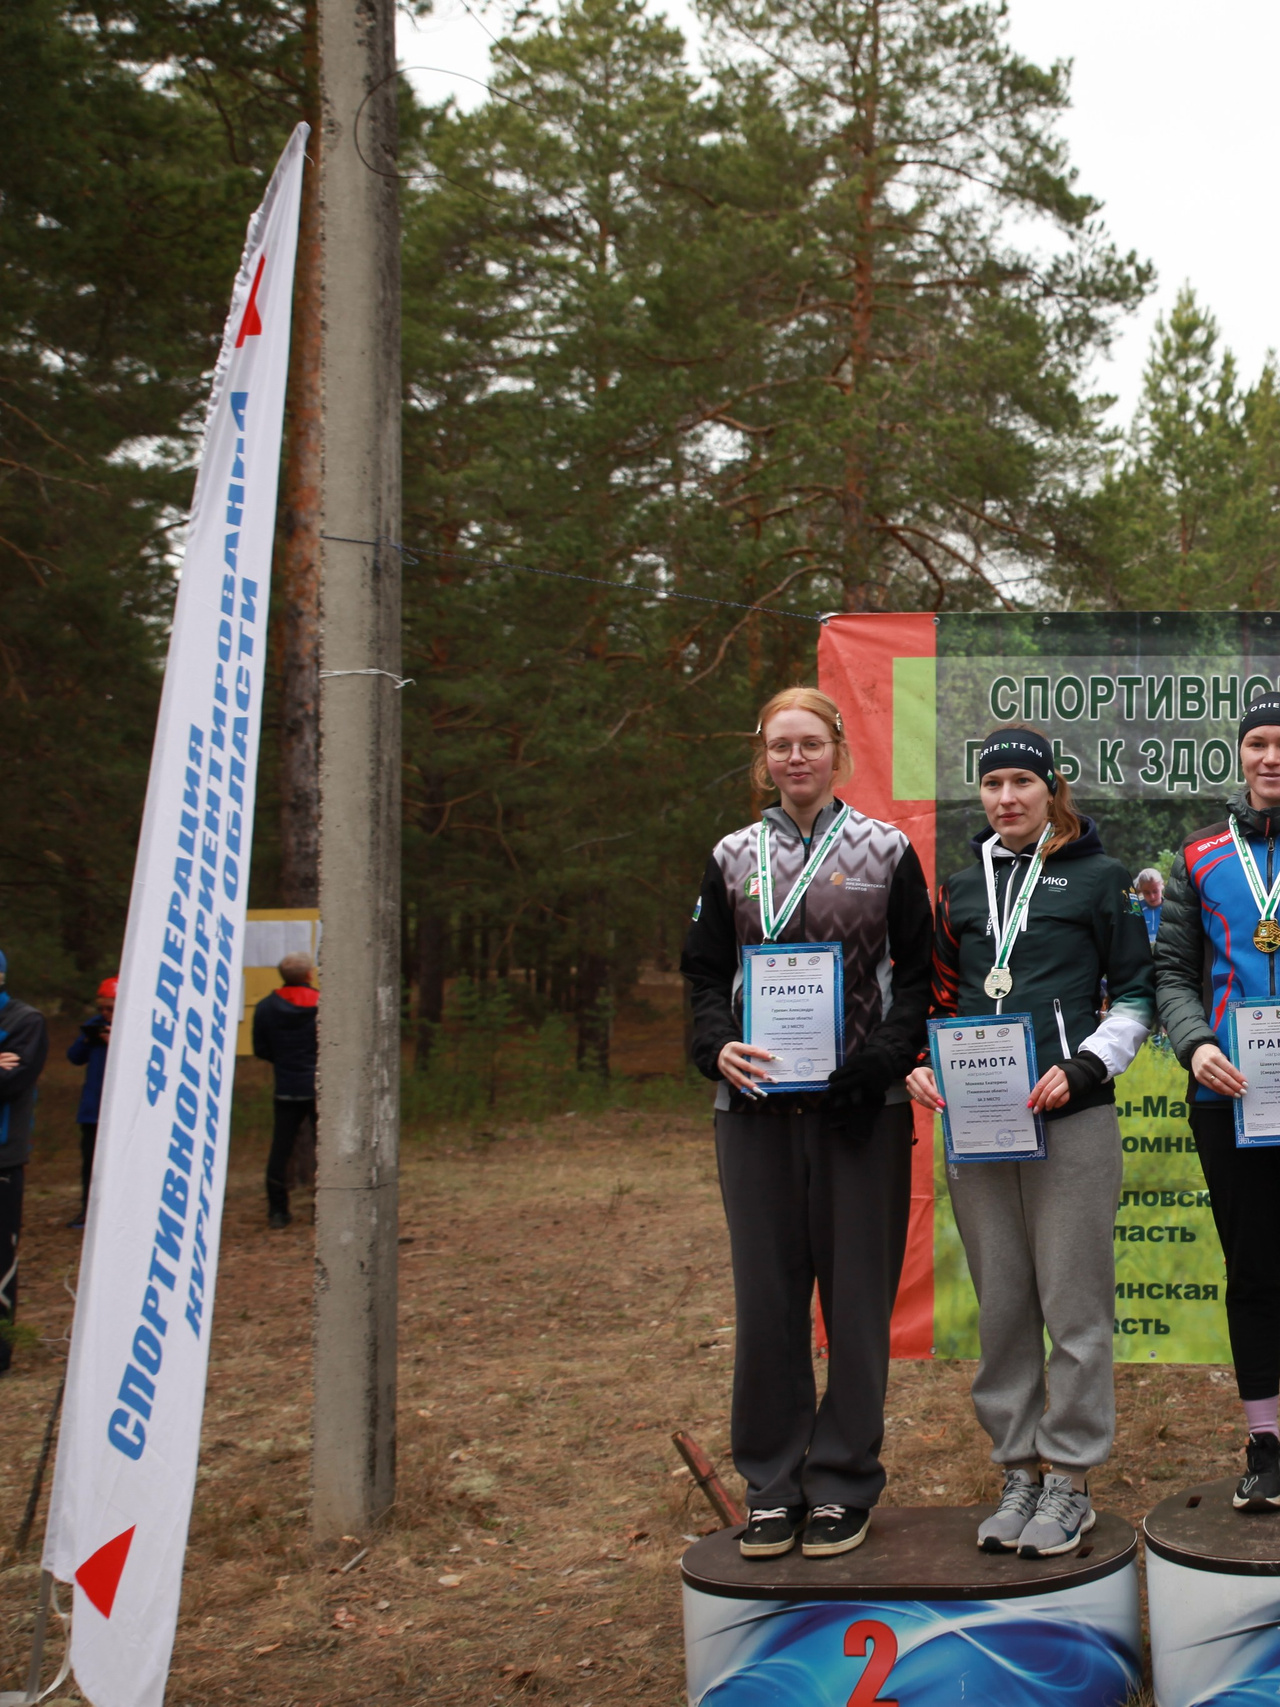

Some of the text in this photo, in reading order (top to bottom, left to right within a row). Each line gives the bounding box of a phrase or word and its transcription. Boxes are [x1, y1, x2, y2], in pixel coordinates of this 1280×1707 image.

[1099, 738, 1126, 785] К
[145, 724, 205, 1108] ФЕДЕРАЦИЯ
[184, 577, 259, 1342] КУРГАНСКОЙ ОБЛАСТИ
[761, 984, 824, 996] ГРАМОТА
[950, 1056, 1017, 1070] ГРАМОТА
[107, 1006, 204, 1461] СПОРТИВНОГО
[1113, 1224, 1197, 1243] ласть
[844, 1619, 899, 1707] 2
